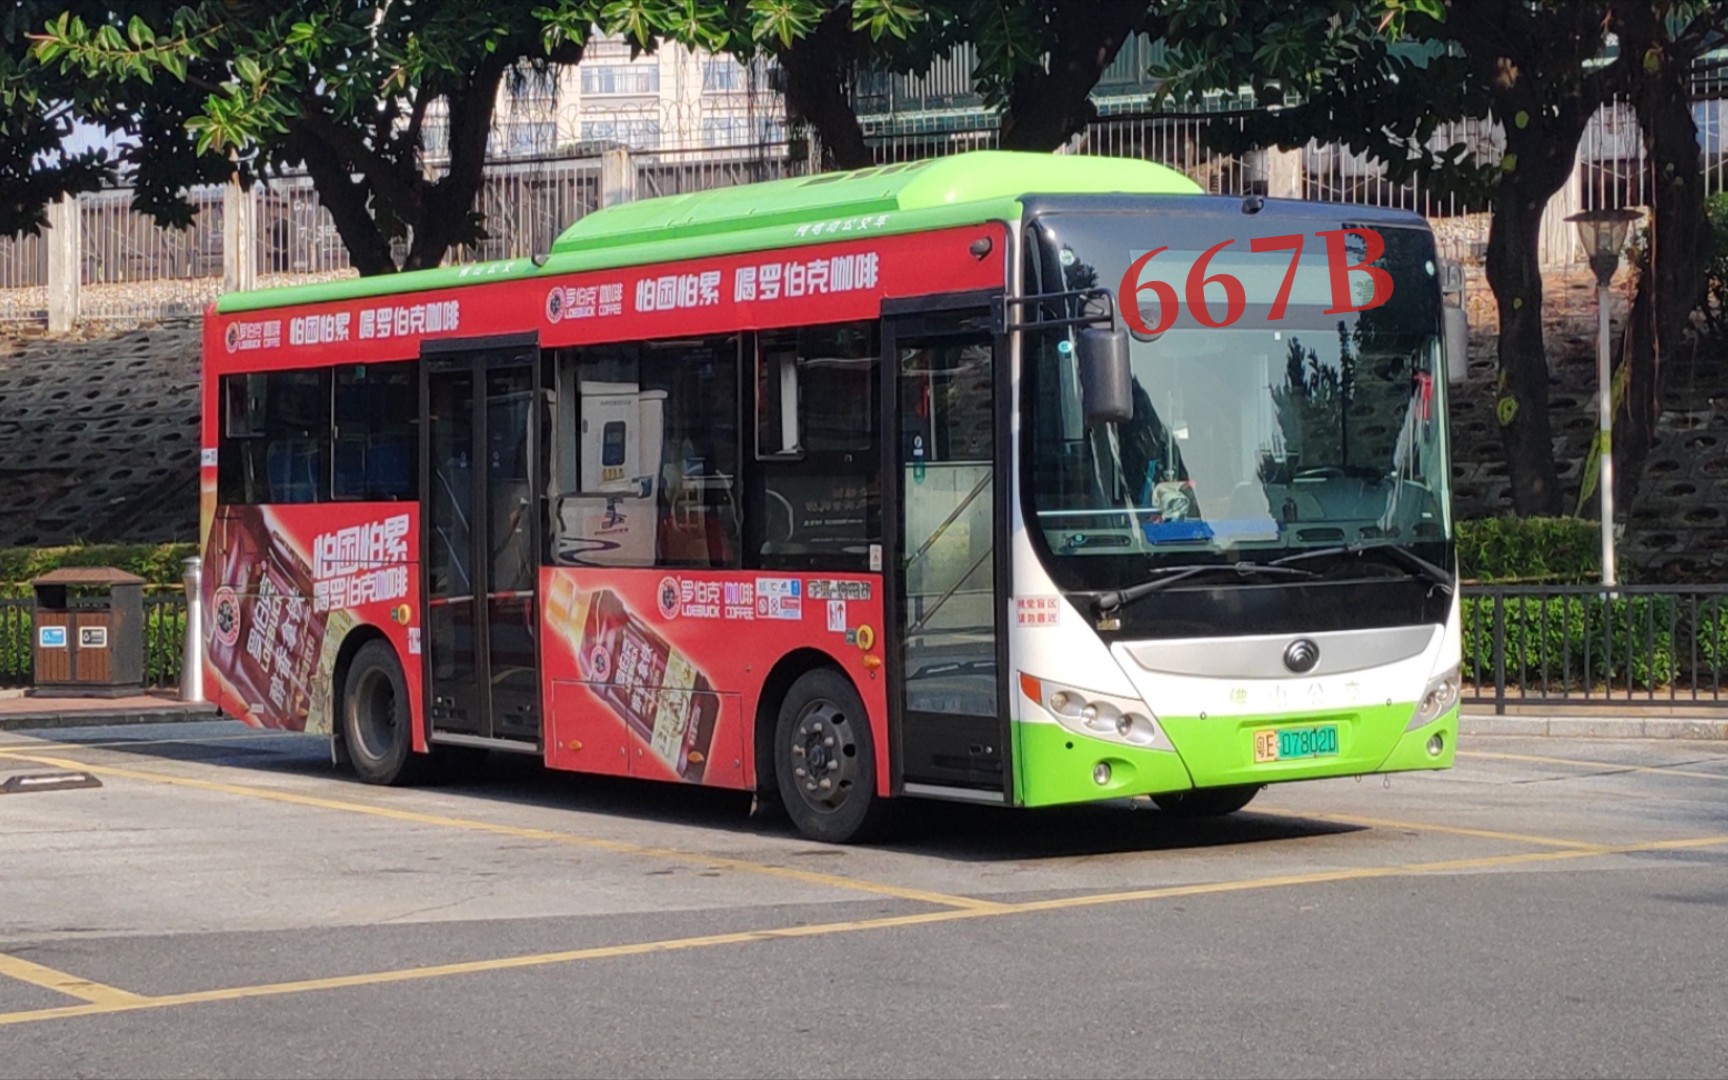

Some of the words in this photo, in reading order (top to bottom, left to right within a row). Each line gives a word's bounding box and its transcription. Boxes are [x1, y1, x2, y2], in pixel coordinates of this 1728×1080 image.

[564, 287, 597, 308] 罗伯克
[599, 283, 624, 303] 咖啡
[635, 270, 721, 312] 怕困怕累
[734, 252, 879, 302] 喝罗伯克咖啡
[289, 312, 351, 344] 怕困怕累
[358, 300, 460, 340] 喝罗伯克咖啡
[598, 302, 623, 316] COFFEE
[313, 513, 410, 579] 怕困怕累
[313, 565, 408, 614] 喝罗伯克咖啡
[681, 580, 721, 603] 罗伯克
[724, 581, 754, 604] 咖啡
[681, 604, 721, 618] LOEBUCK
[725, 606, 754, 620] COFFEE
